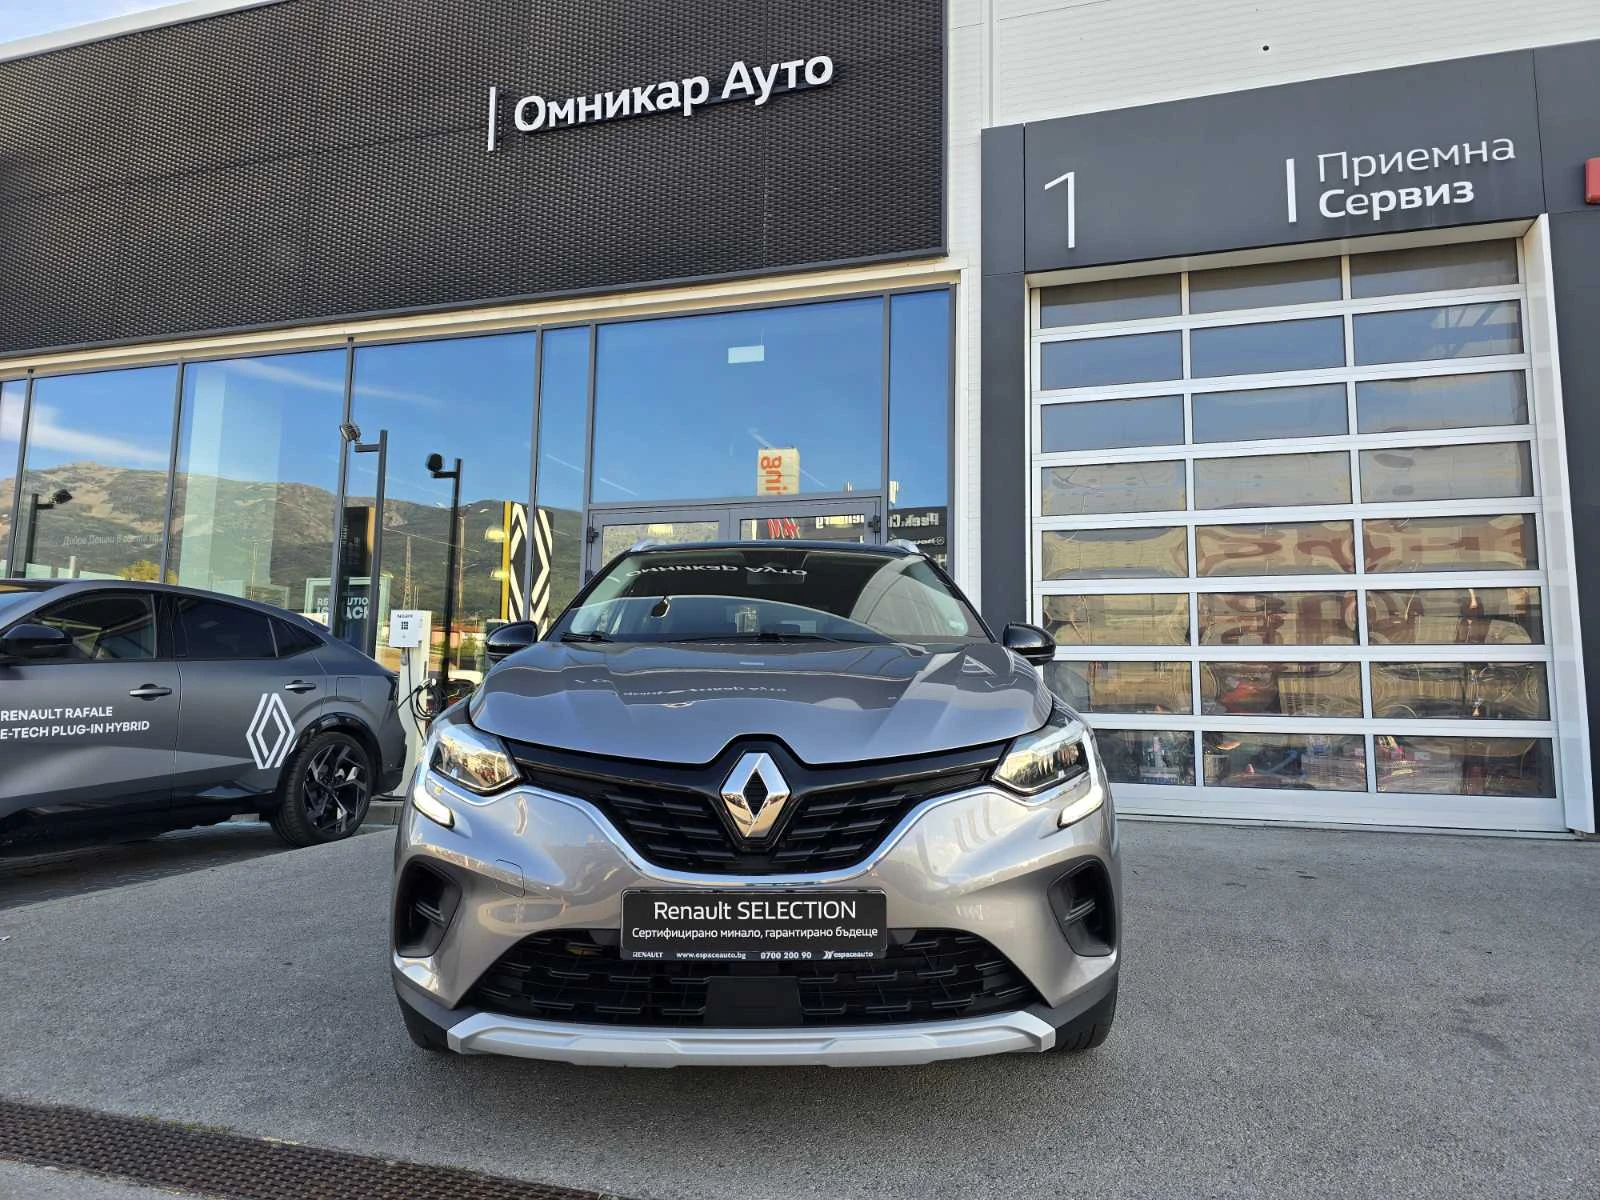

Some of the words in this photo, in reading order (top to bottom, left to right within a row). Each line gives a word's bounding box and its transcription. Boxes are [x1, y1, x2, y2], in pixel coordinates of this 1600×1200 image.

[514, 75, 710, 132] Омникар
[721, 55, 834, 106] Ауто
[1317, 137, 1516, 186] Приемна
[1044, 171, 1076, 248] 1
[1319, 181, 1475, 221] Сервиз
[1, 708, 62, 721] RENAULT
[65, 706, 113, 718] RAFALE
[0, 726, 48, 739] E-TECH
[52, 723, 103, 736] PLUG-IN
[106, 721, 150, 732] HYBRID
[653, 901, 732, 920] Renault
[737, 901, 857, 920] SELECTION
[632, 927, 718, 939] Сертифицирано
[720, 928, 763, 939] минало,
[765, 927, 833, 939] гарантирано
[835, 926, 878, 938] бъдеще
[676, 951, 747, 959] www.espaceauto.bg
[760, 951, 781, 959] 0700
[784, 951, 799, 959] 200
[801, 951, 812, 959] 90
[833, 951, 874, 959] espaceauto
